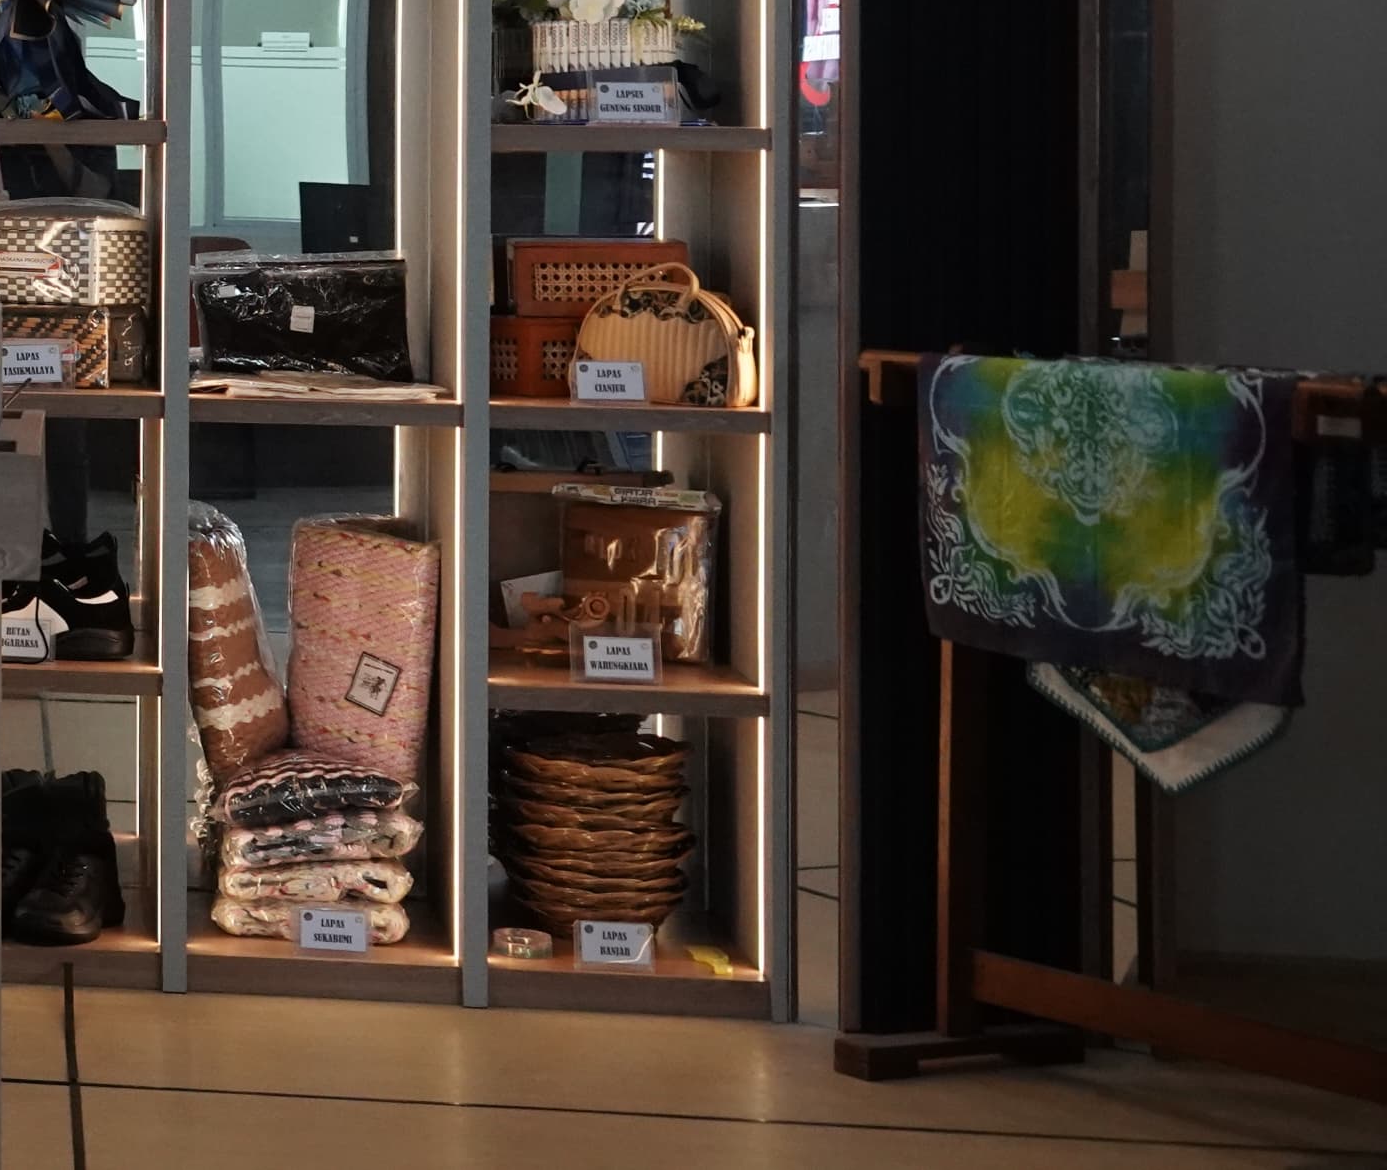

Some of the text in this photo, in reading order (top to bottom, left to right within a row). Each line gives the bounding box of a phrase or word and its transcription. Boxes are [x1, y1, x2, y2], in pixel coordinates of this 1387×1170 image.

[600, 103, 662, 113] GUNUNG SINDUR
[16, 352, 40, 361] LAPAS
[3, 366, 55, 376] TASIKMALAYA
[597, 369, 622, 378] LAPAS
[594, 383, 626, 393] CIANJUR
[1, 638, 39, 648] IGARAKSA
[606, 646, 631, 655] LAPAS
[589, 660, 649, 671] WARUNGKIARA
[321, 918, 345, 928] LAPAS
[313, 933, 353, 944] SUKABUMI
[602, 930, 627, 941] LAPAS
[600, 946, 631, 956] BANJAR
